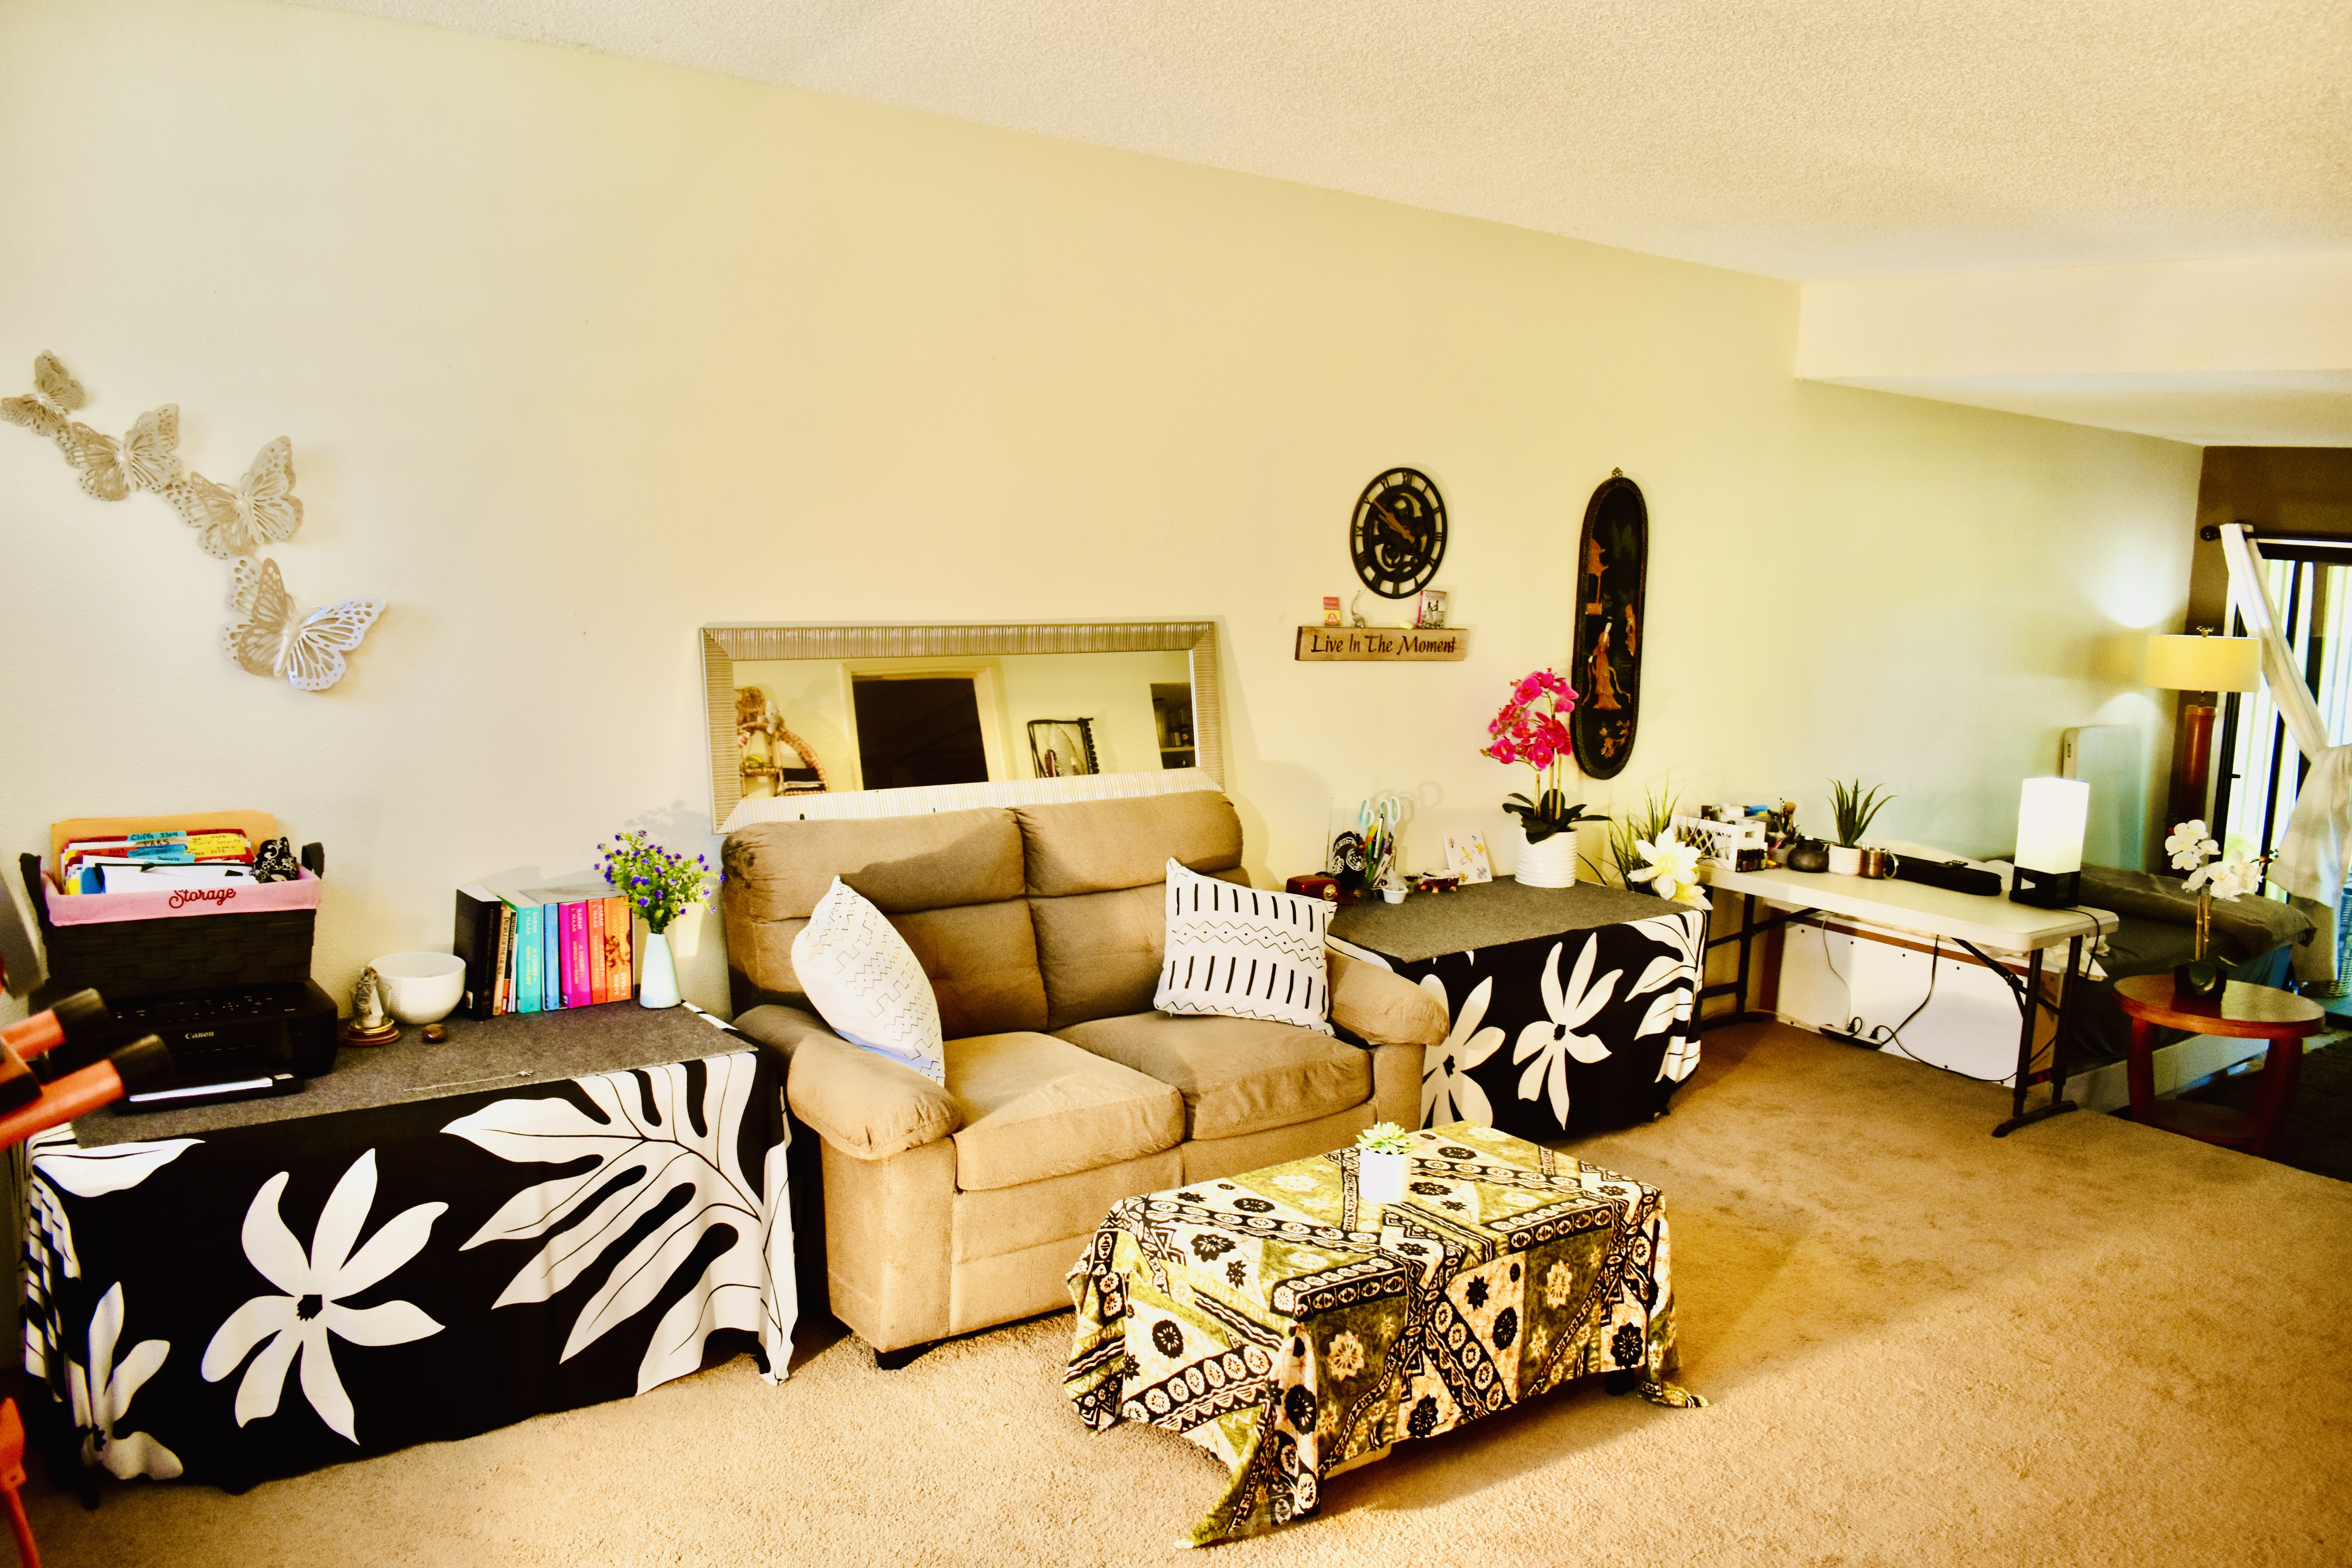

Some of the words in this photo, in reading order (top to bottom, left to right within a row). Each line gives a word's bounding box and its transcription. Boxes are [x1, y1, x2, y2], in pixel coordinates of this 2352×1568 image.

[1311, 635, 1343, 653] Live
[1350, 634, 1360, 652] In
[1365, 634, 1392, 653] The
[1396, 635, 1455, 655] Moment
[169, 888, 236, 909] Storage
